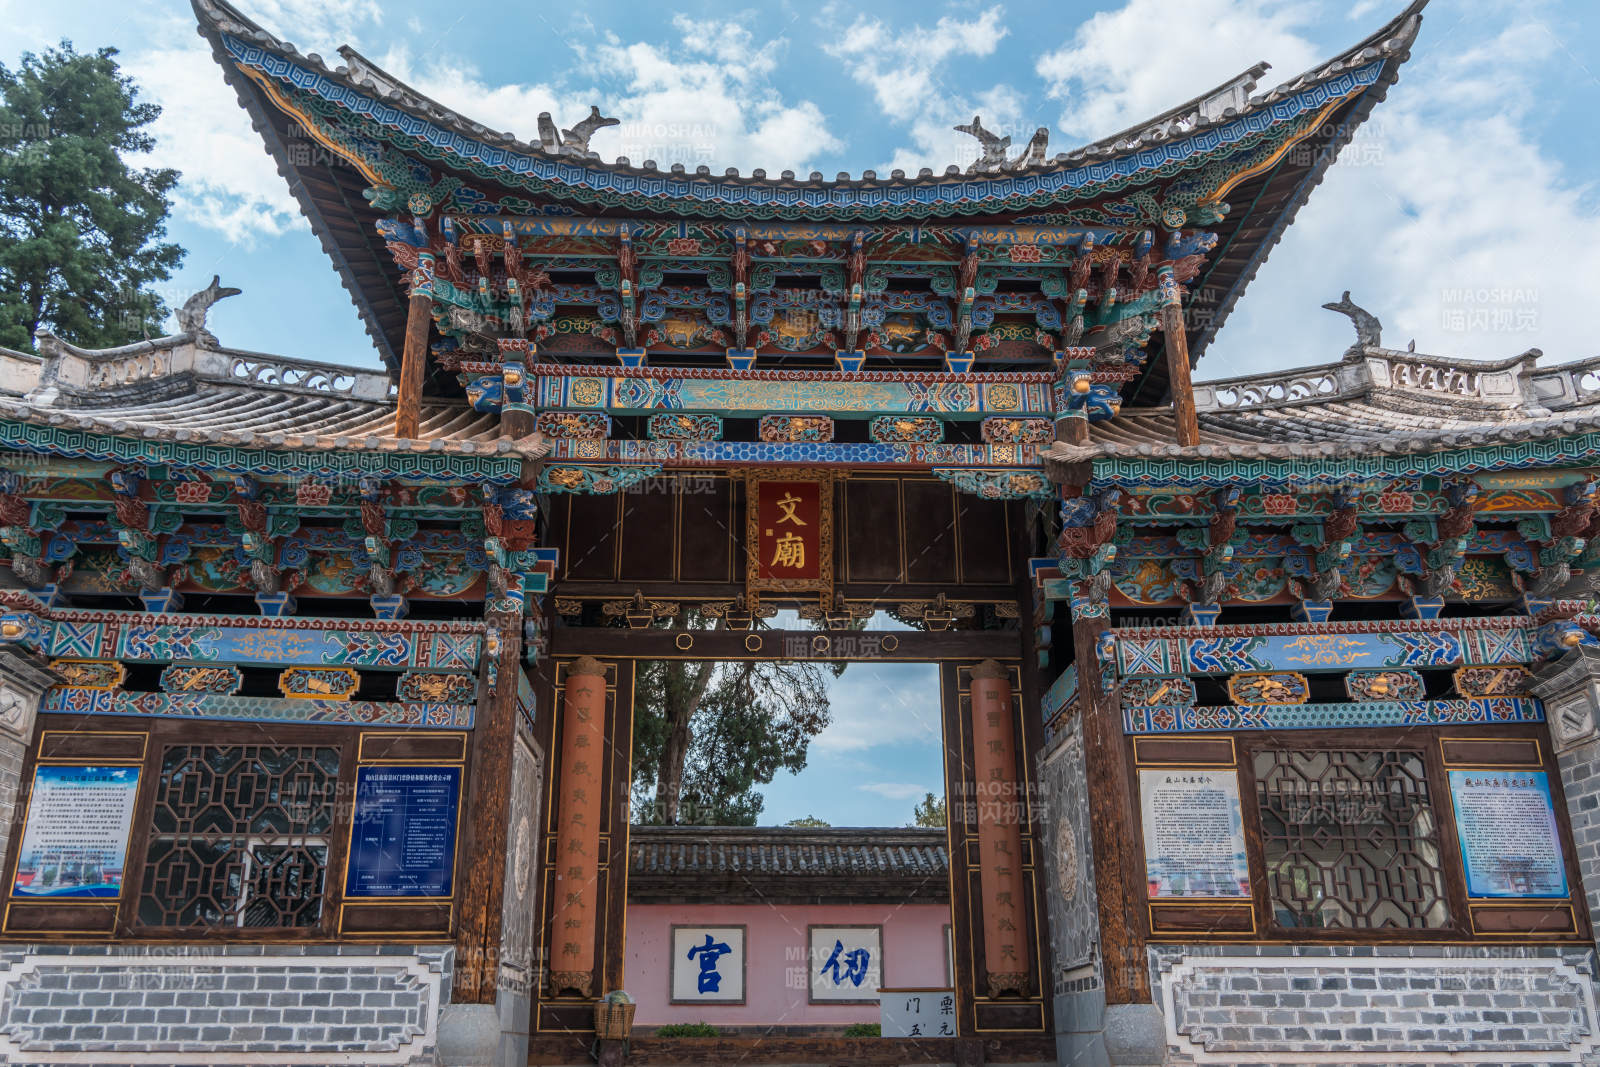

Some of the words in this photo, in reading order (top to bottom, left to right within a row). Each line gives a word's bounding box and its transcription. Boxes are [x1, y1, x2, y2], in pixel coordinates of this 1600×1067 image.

[771, 492, 807, 568] 文廟
[687, 934, 732, 994] 宫
[820, 939, 871, 987] 仞
